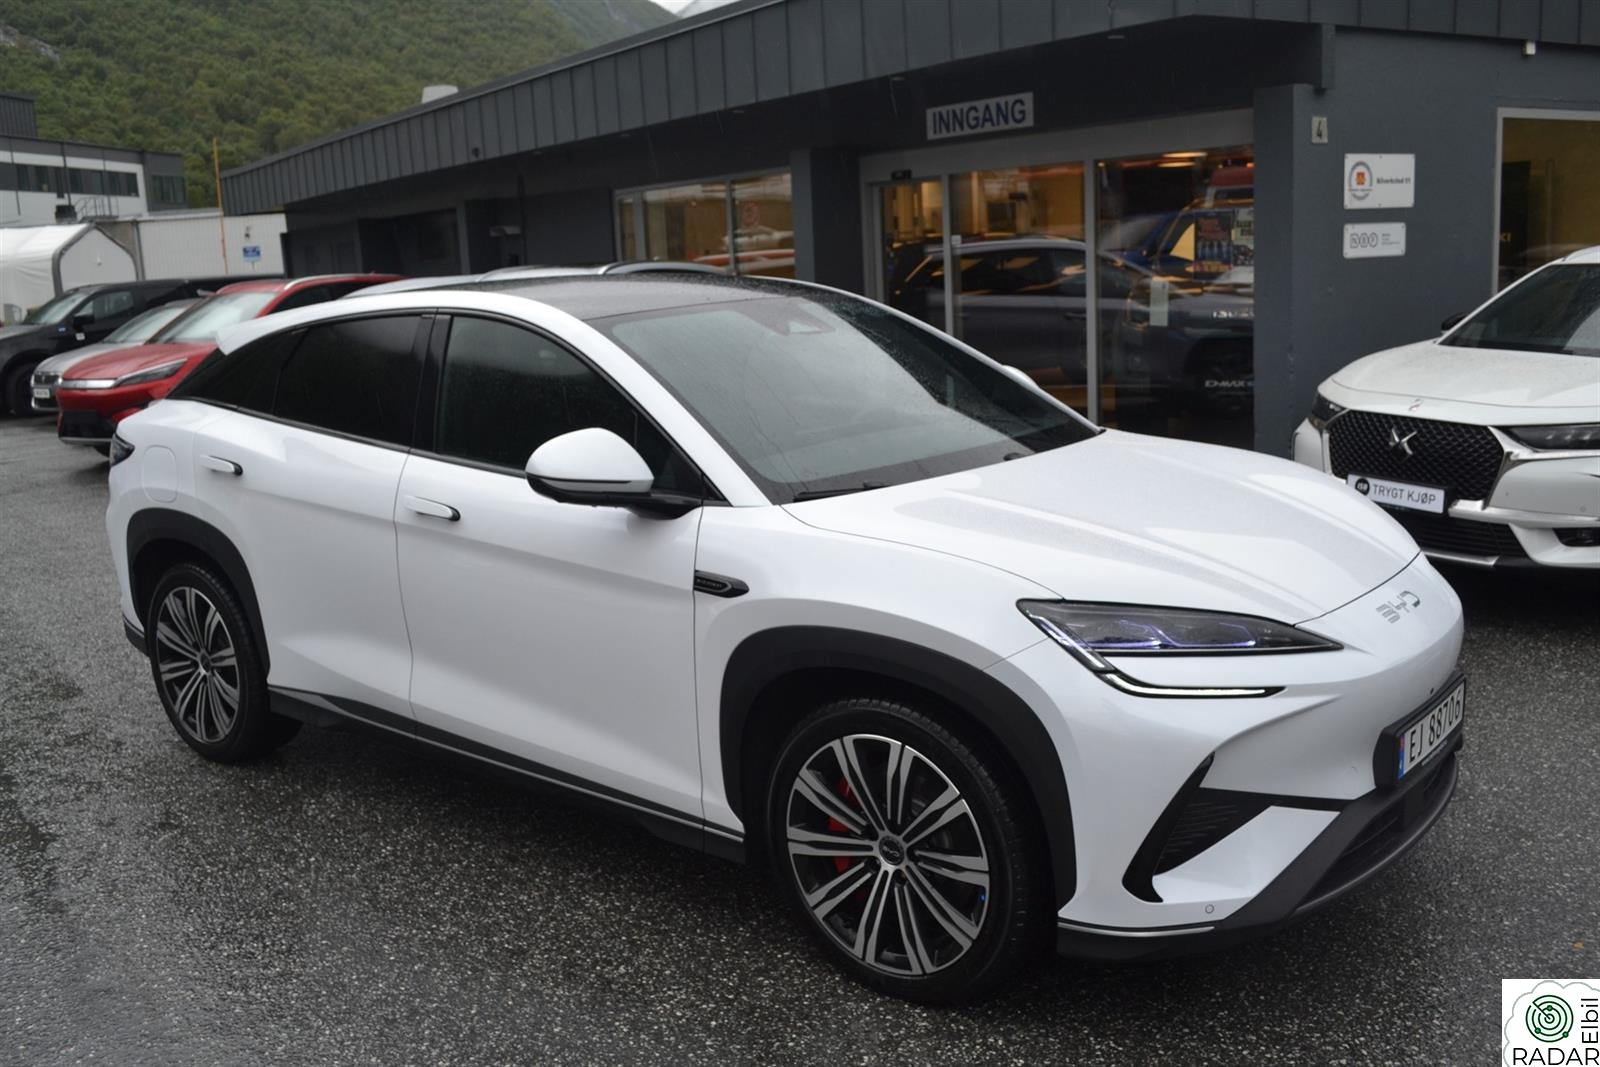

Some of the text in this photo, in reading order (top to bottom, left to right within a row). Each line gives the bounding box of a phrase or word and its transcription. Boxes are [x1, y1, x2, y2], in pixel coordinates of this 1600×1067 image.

[933, 99, 1026, 134] INNGANG
[1372, 484, 1405, 500] TRYGT
[1407, 490, 1436, 505] KJØP
[1409, 723, 1424, 763] EJ
[1429, 688, 1461, 746] 88706
